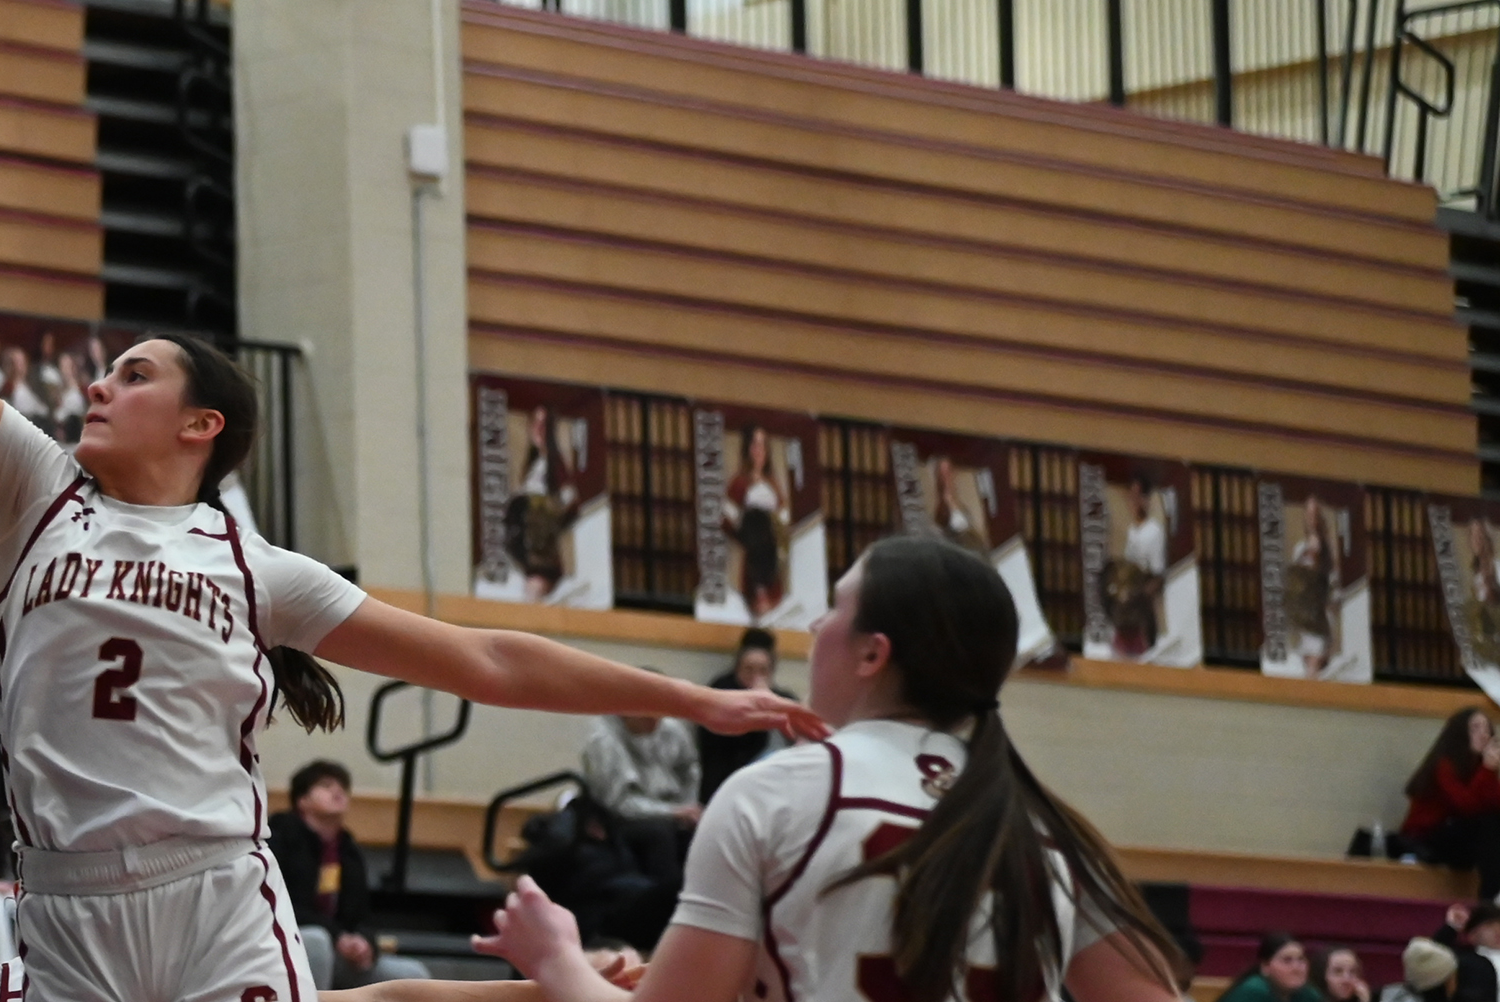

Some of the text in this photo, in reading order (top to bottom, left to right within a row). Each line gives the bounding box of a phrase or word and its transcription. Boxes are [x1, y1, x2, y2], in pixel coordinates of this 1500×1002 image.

[22, 552, 235, 645] LADY KNIGHTS
[91, 636, 143, 721] 2
